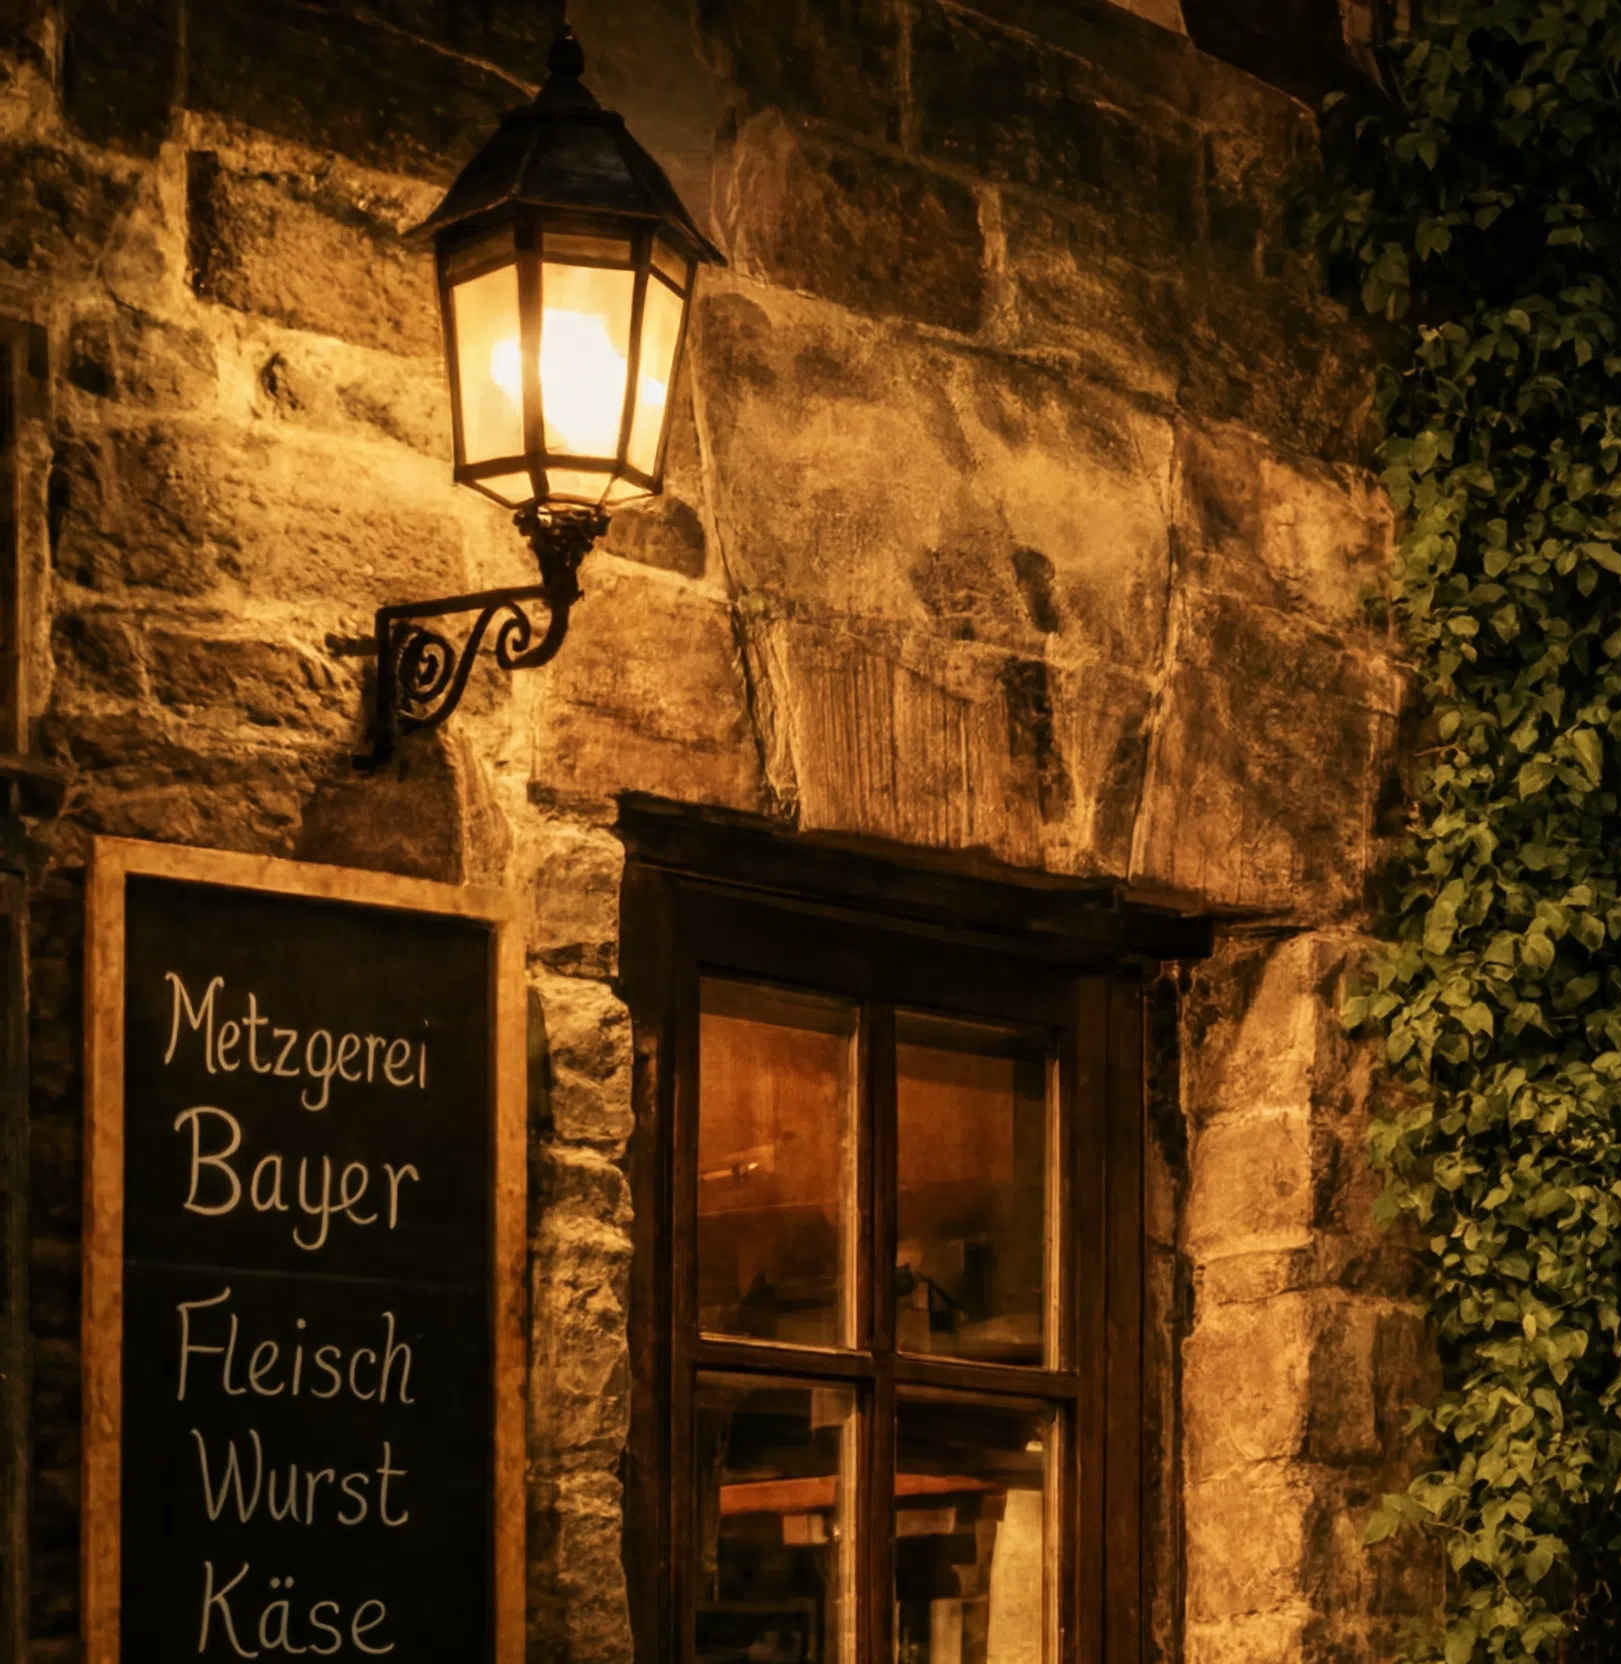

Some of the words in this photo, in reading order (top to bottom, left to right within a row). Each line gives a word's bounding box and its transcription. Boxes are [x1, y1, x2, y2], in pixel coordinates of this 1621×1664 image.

[163, 970, 429, 1112] Metzgerei
[173, 1105, 420, 1251] Bayer
[176, 1286, 416, 1404] Fleisch
[190, 1428, 409, 1527] Wurst
[198, 1560, 396, 1660] Käse
